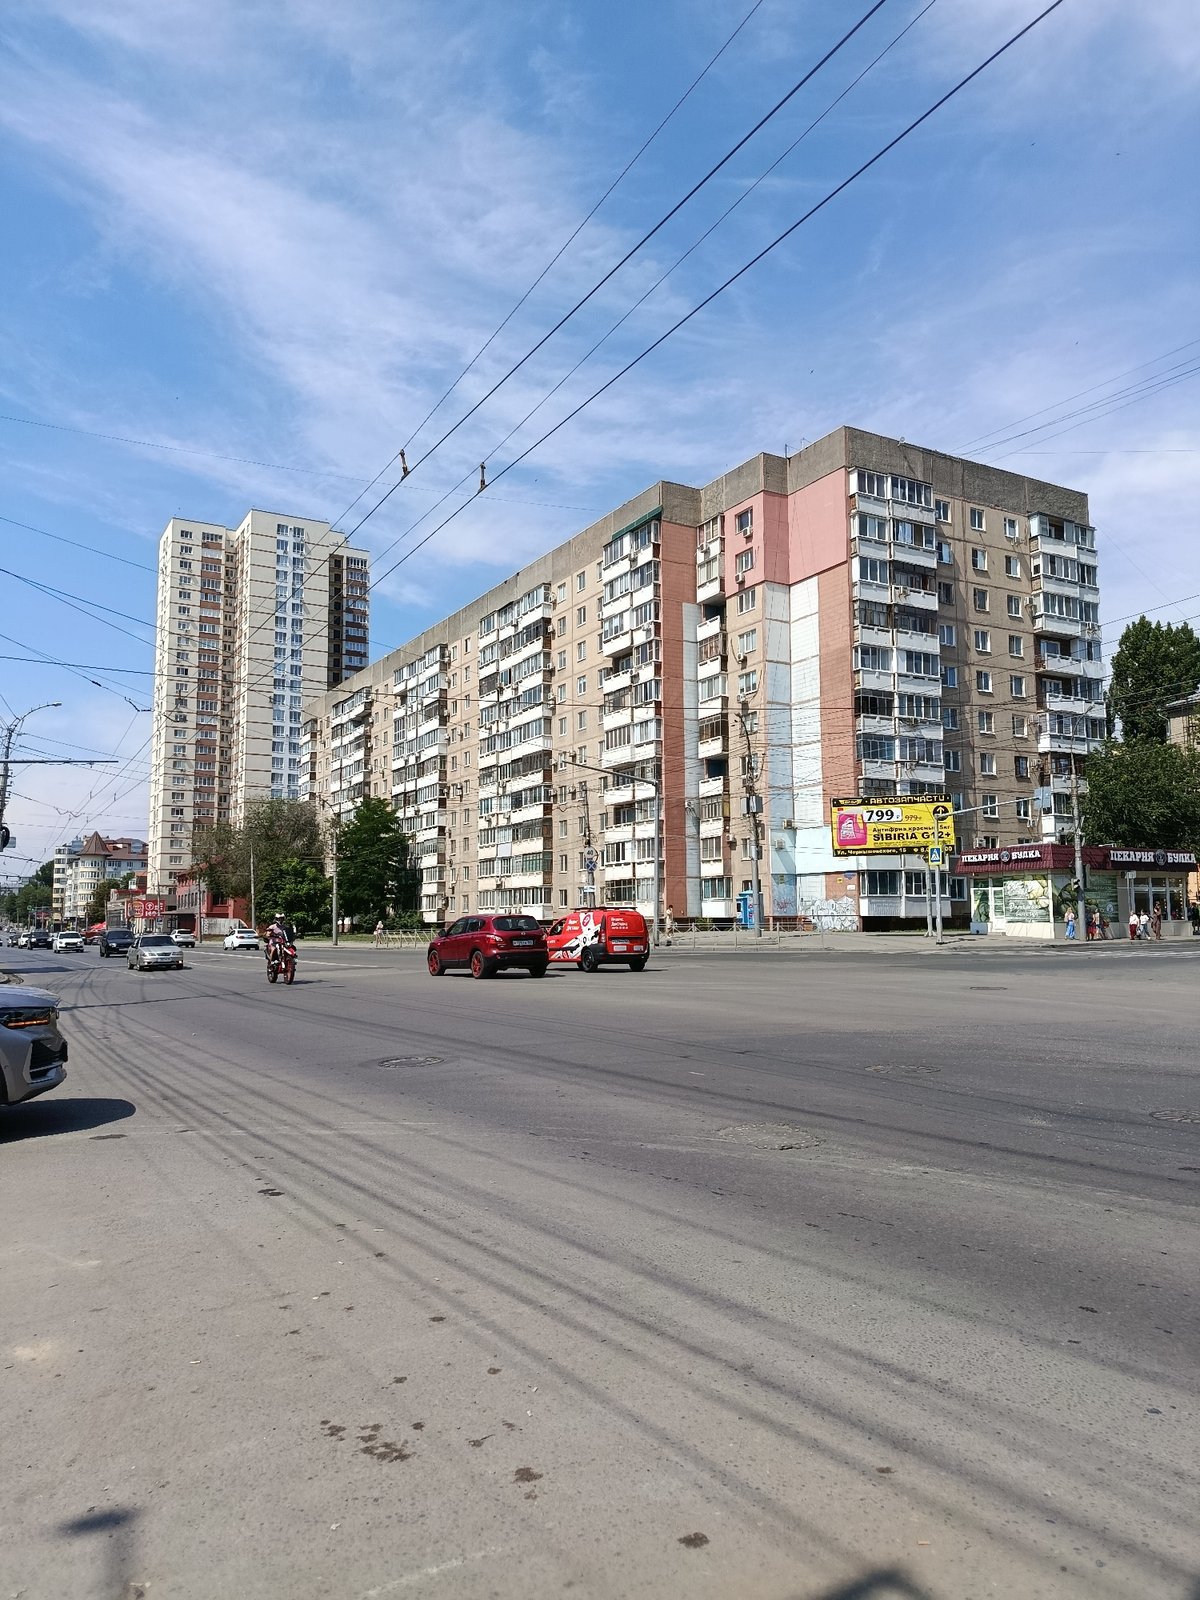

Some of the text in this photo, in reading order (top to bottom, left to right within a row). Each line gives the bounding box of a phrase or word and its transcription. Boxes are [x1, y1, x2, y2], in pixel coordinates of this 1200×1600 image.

[869, 795, 945, 805] АВТОЗАПЧАСТИ
[866, 809, 894, 821] 799
[873, 833, 918, 841] SIBIRIA
[962, 853, 999, 862] ПЕКАРНЯ
[1110, 850, 1196, 863] ПЕКАРНЯ БУЛКА
